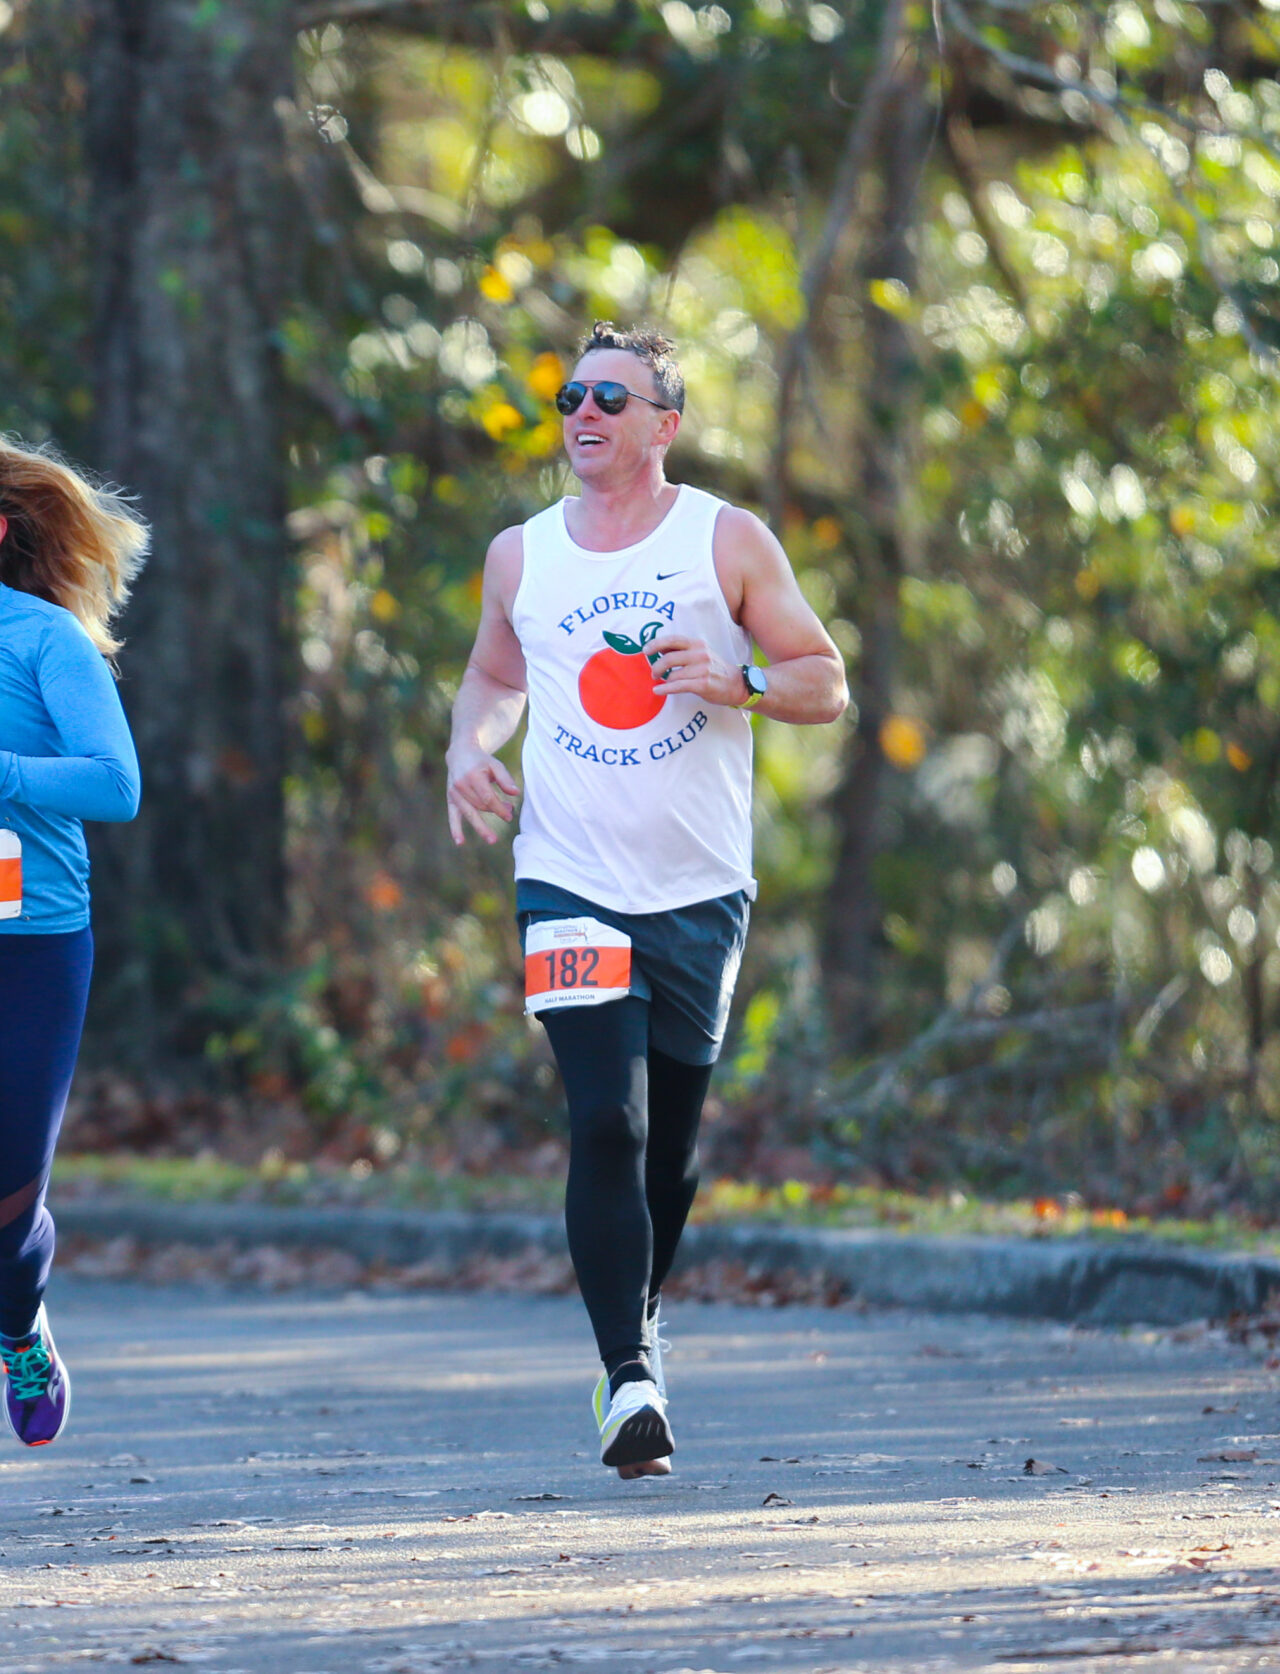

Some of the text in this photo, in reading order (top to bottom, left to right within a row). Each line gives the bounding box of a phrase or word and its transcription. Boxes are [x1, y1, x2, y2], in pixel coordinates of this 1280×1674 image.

[557, 591, 676, 636] FLORIDA
[553, 710, 709, 766] TRACK CLUB
[545, 948, 600, 989] 182
[558, 994, 596, 1002] MARATHON
